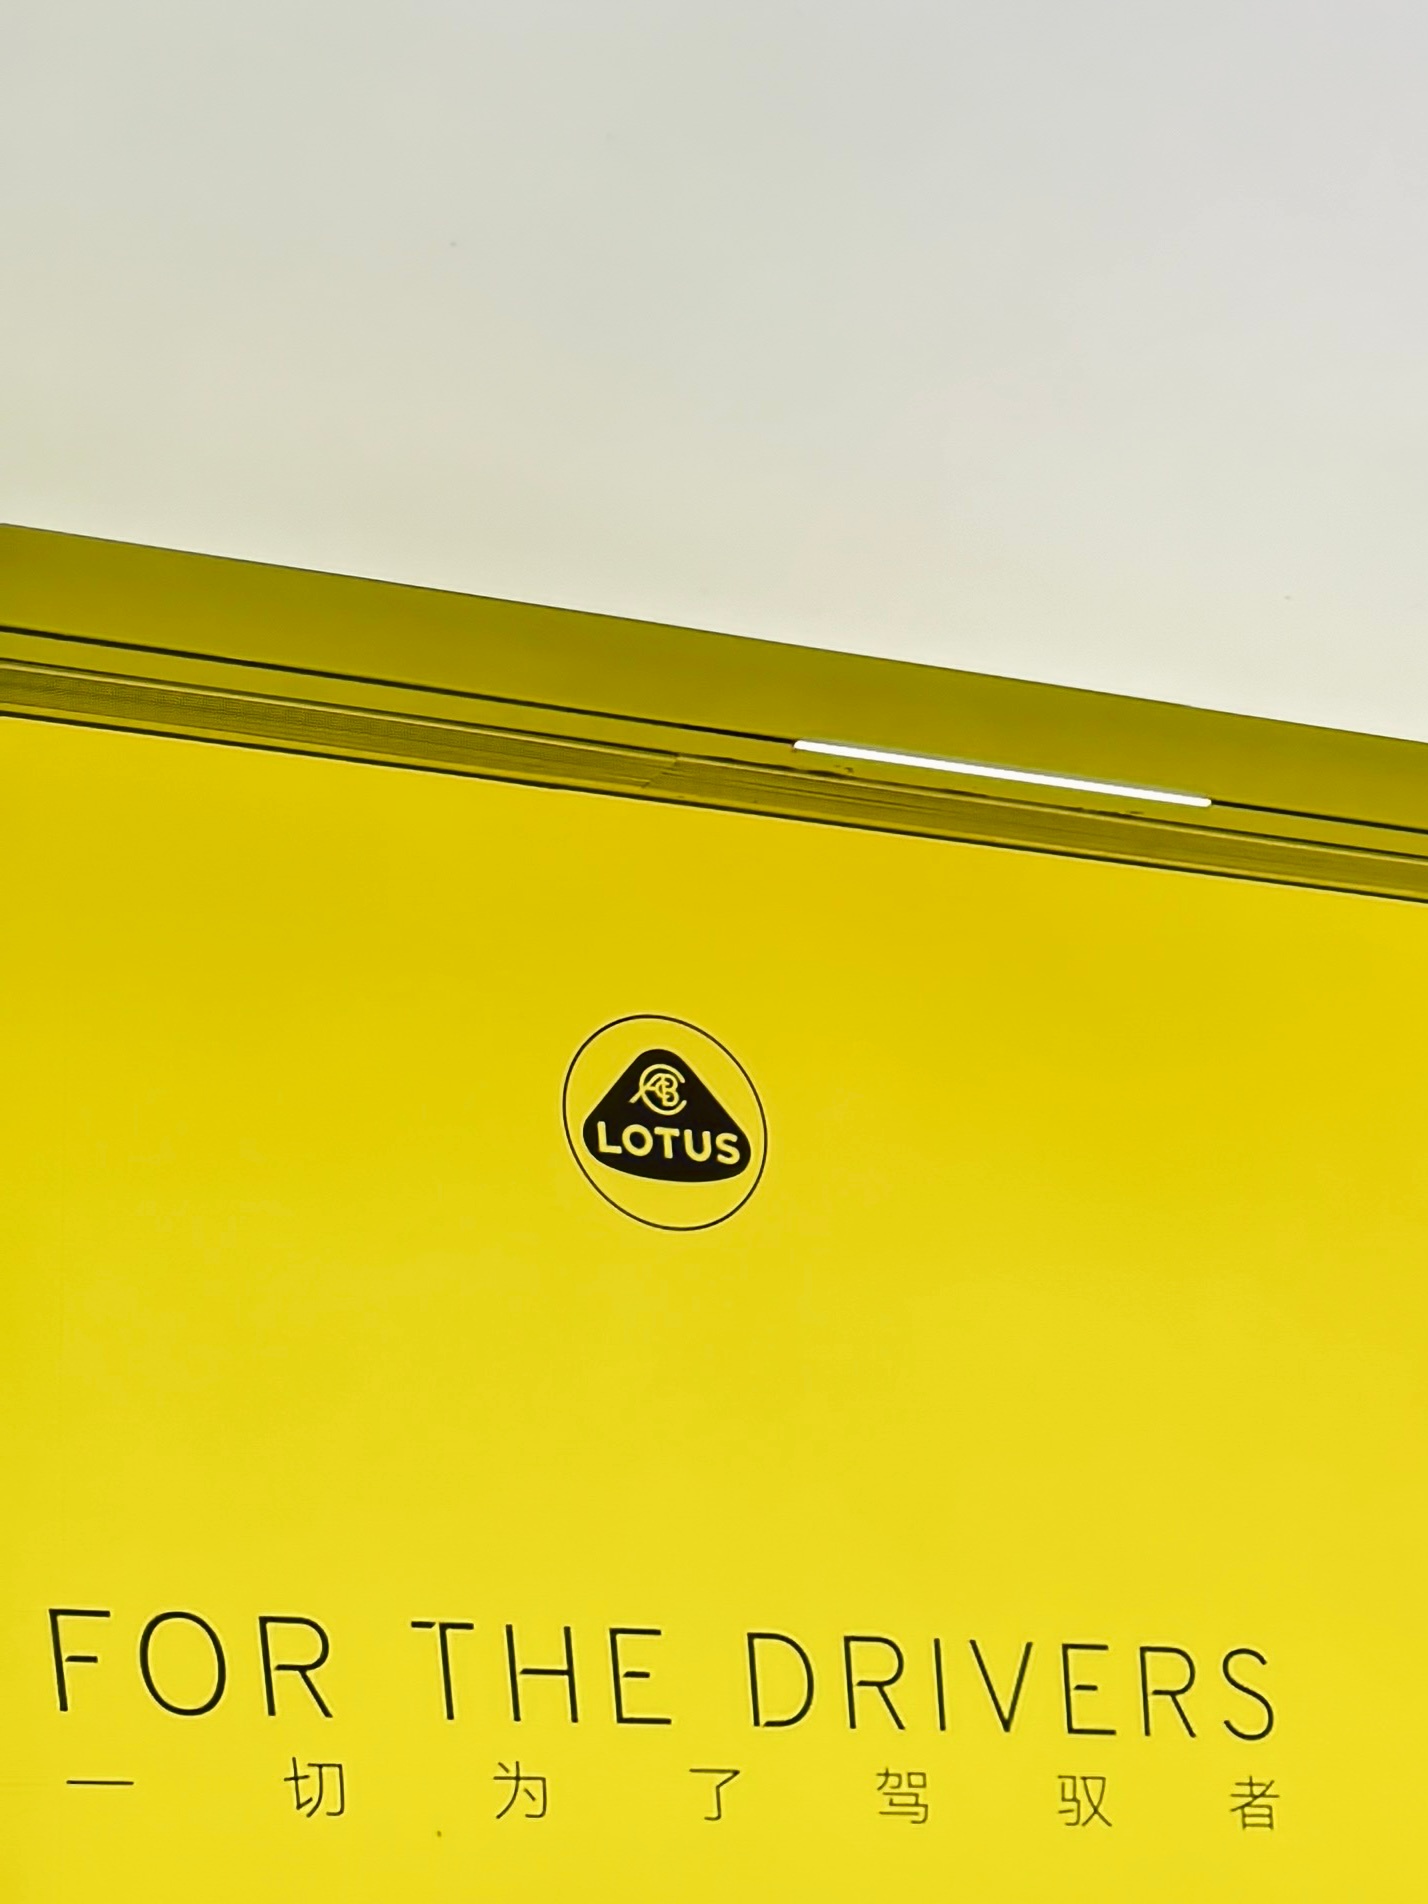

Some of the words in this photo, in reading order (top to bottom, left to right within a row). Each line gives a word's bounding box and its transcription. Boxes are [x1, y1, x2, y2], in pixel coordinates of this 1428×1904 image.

[596, 1120, 741, 1165] LOTUS
[48, 1608, 333, 1719] FOR
[410, 1620, 672, 1726] THE
[746, 1632, 1275, 1742] DRIVERS
[65, 1756, 1281, 1836] 一切为了驾驭者
